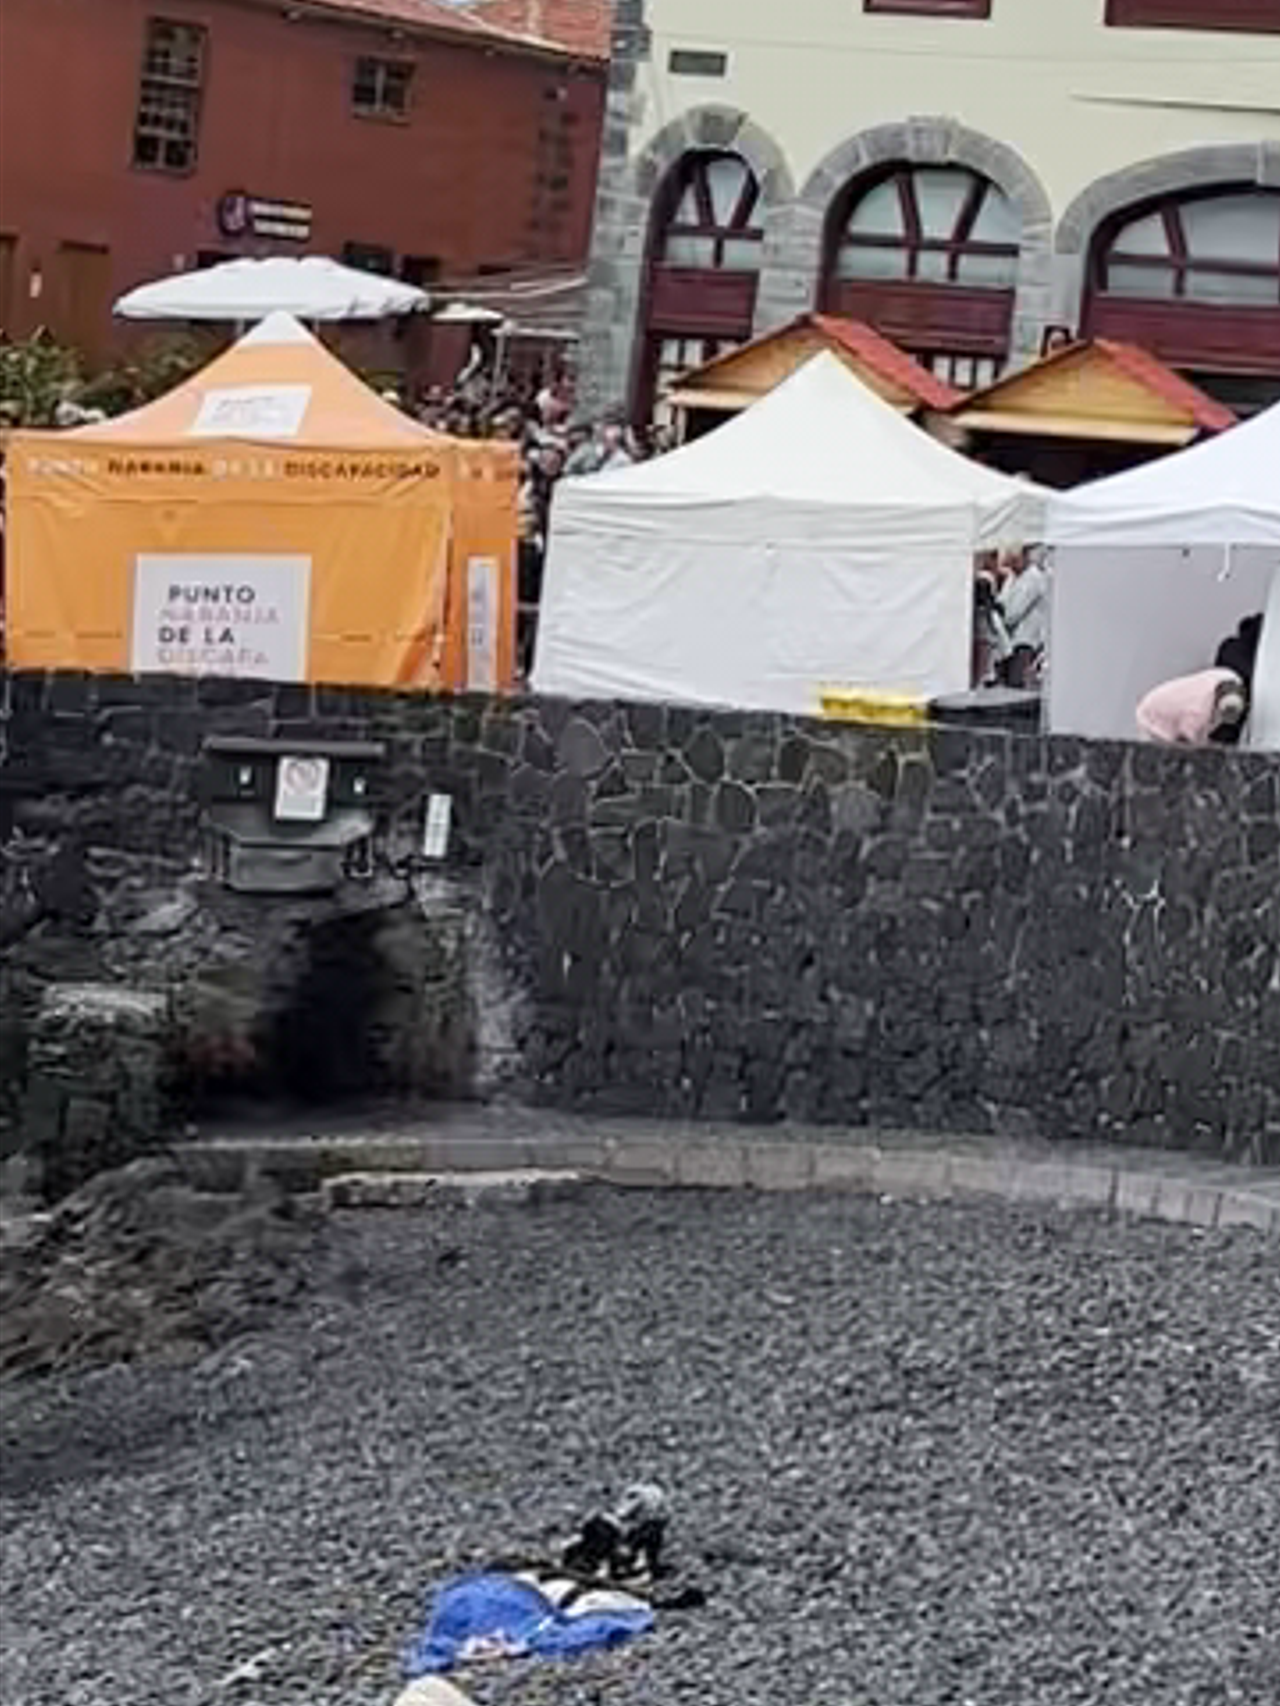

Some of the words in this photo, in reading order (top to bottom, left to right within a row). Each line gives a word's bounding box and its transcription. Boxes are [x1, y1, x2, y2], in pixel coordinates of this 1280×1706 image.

[168, 584, 256, 604] PUNTO
[158, 625, 190, 644] DE
[203, 626, 235, 645] LA
